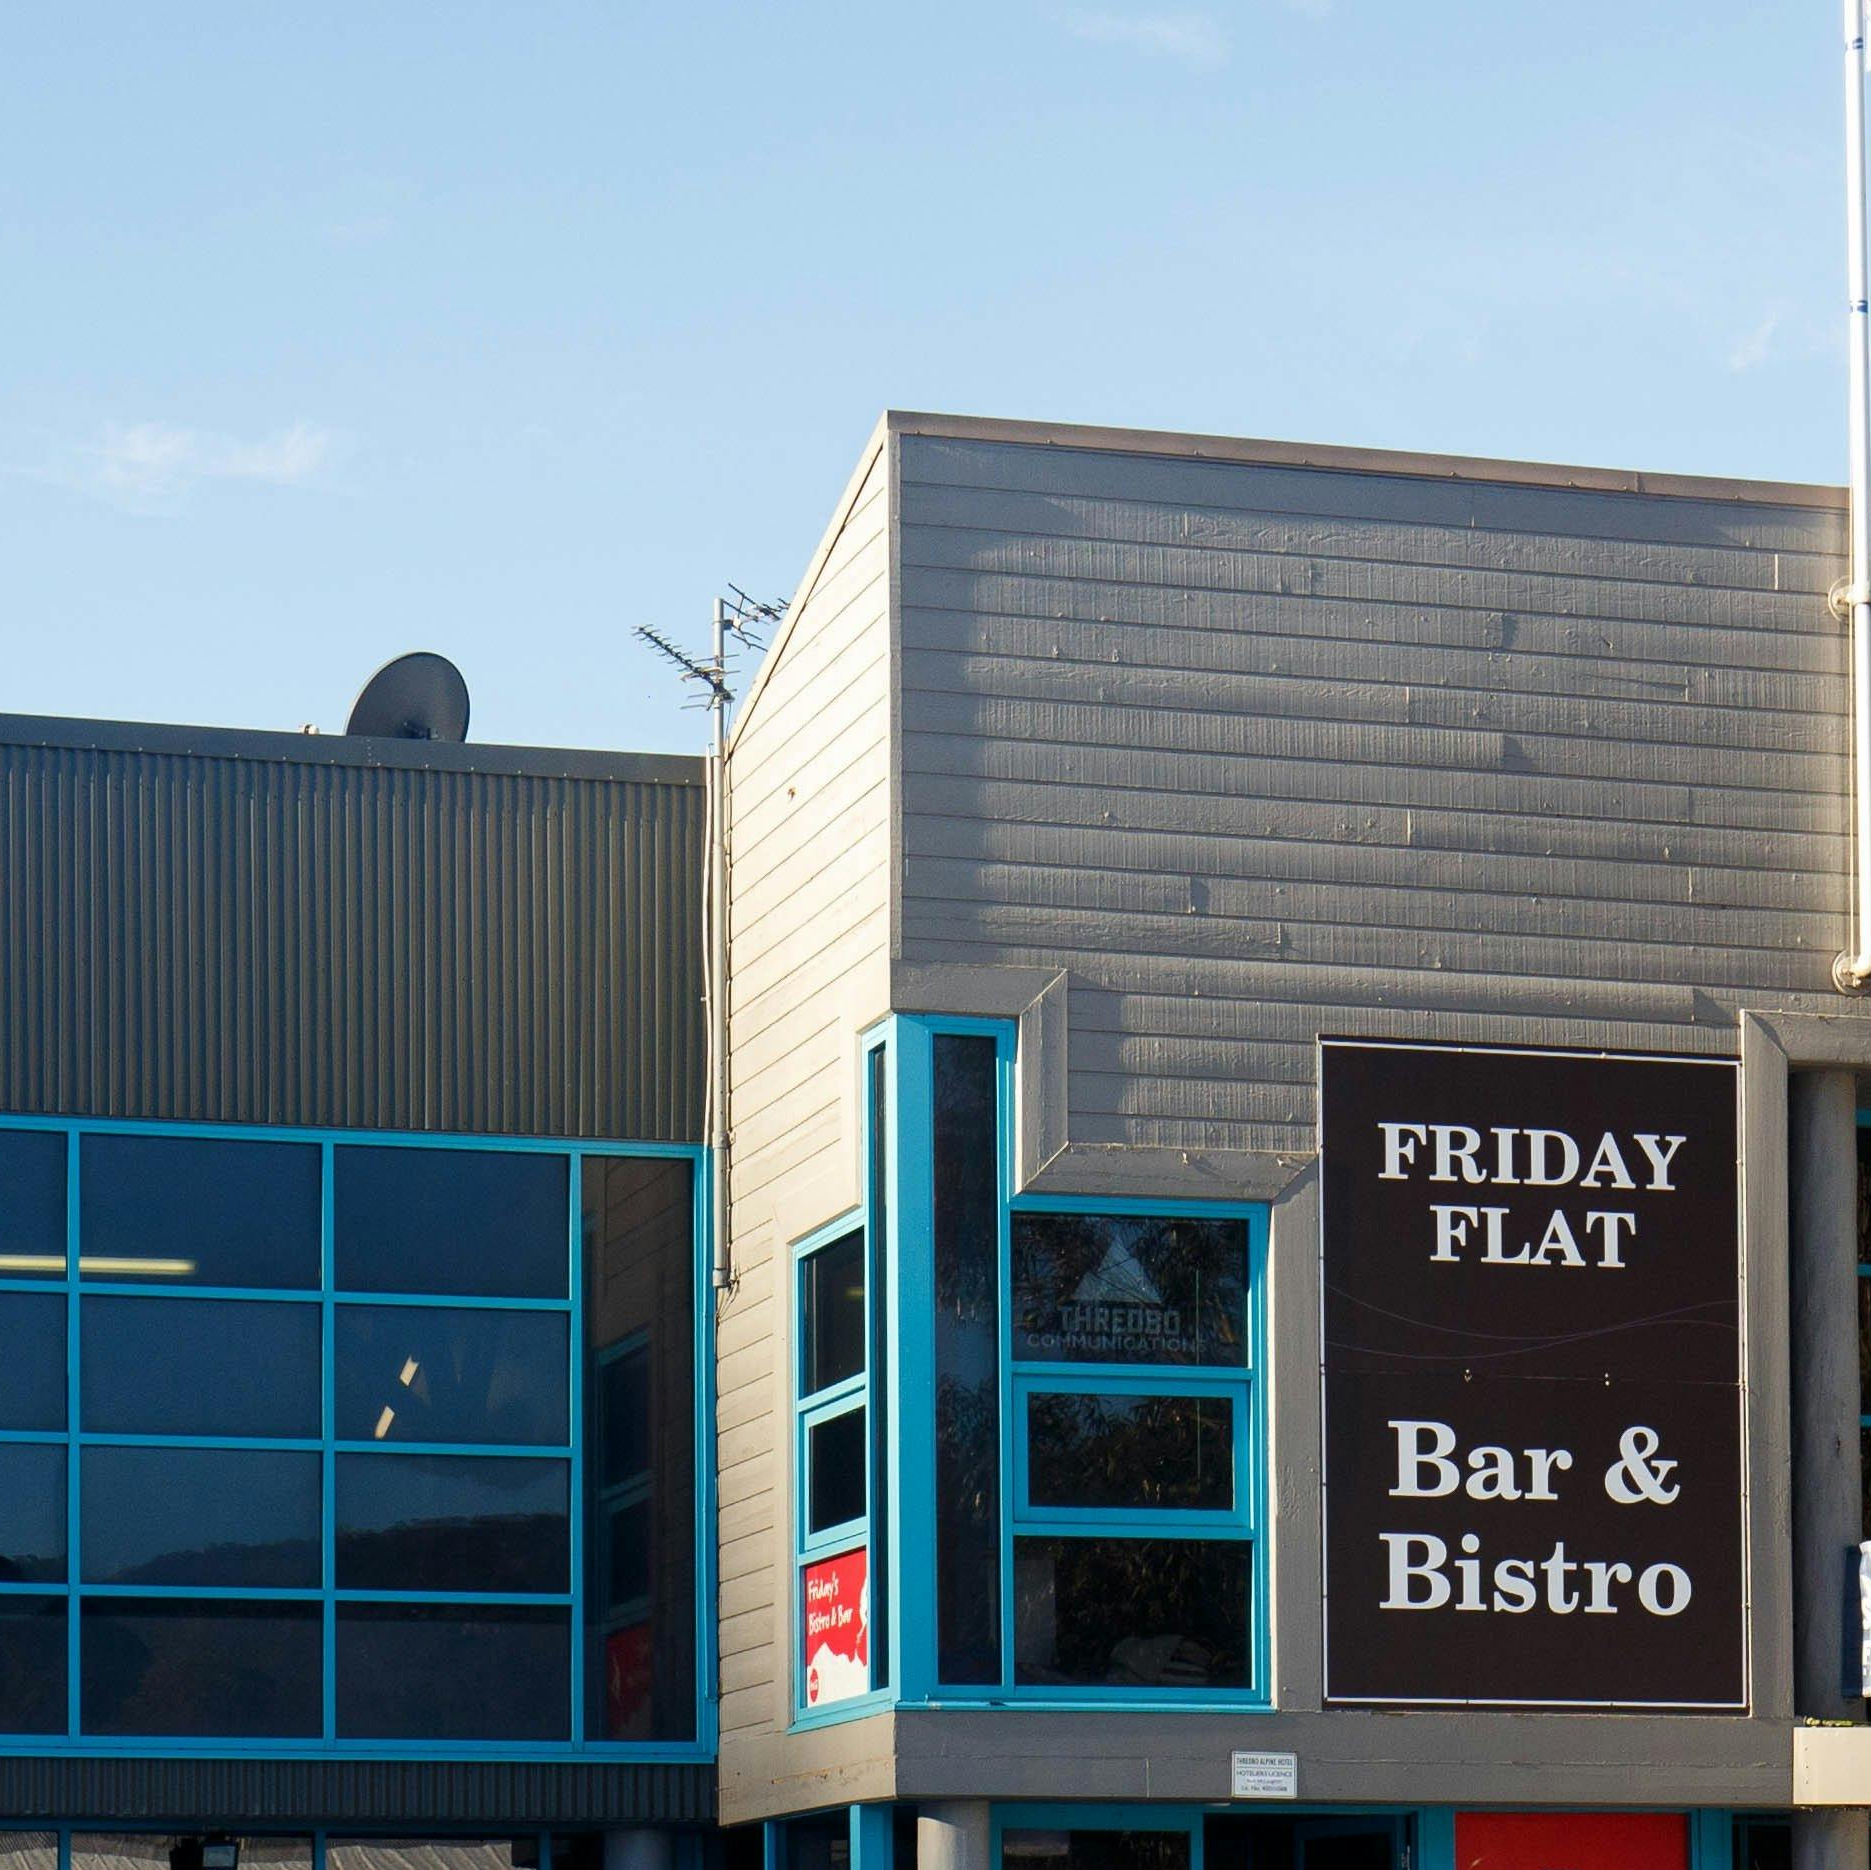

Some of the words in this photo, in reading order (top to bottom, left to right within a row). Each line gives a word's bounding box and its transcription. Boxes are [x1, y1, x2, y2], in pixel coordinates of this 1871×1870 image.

[1377, 1121, 1687, 1191] FRIDAY
[1428, 1204, 1636, 1268] FLAT
[1027, 1332, 1208, 1353] COMMUNICATIONS
[1059, 1303, 1180, 1335] THREDBO
[1387, 1419, 1573, 1501] Bar
[1604, 1425, 1681, 1505] &
[808, 1571, 839, 1602] Friday's
[1378, 1532, 1692, 1615] Bistro
[808, 1611, 830, 1636] Bistro
[838, 1604, 853, 1628] Bar
